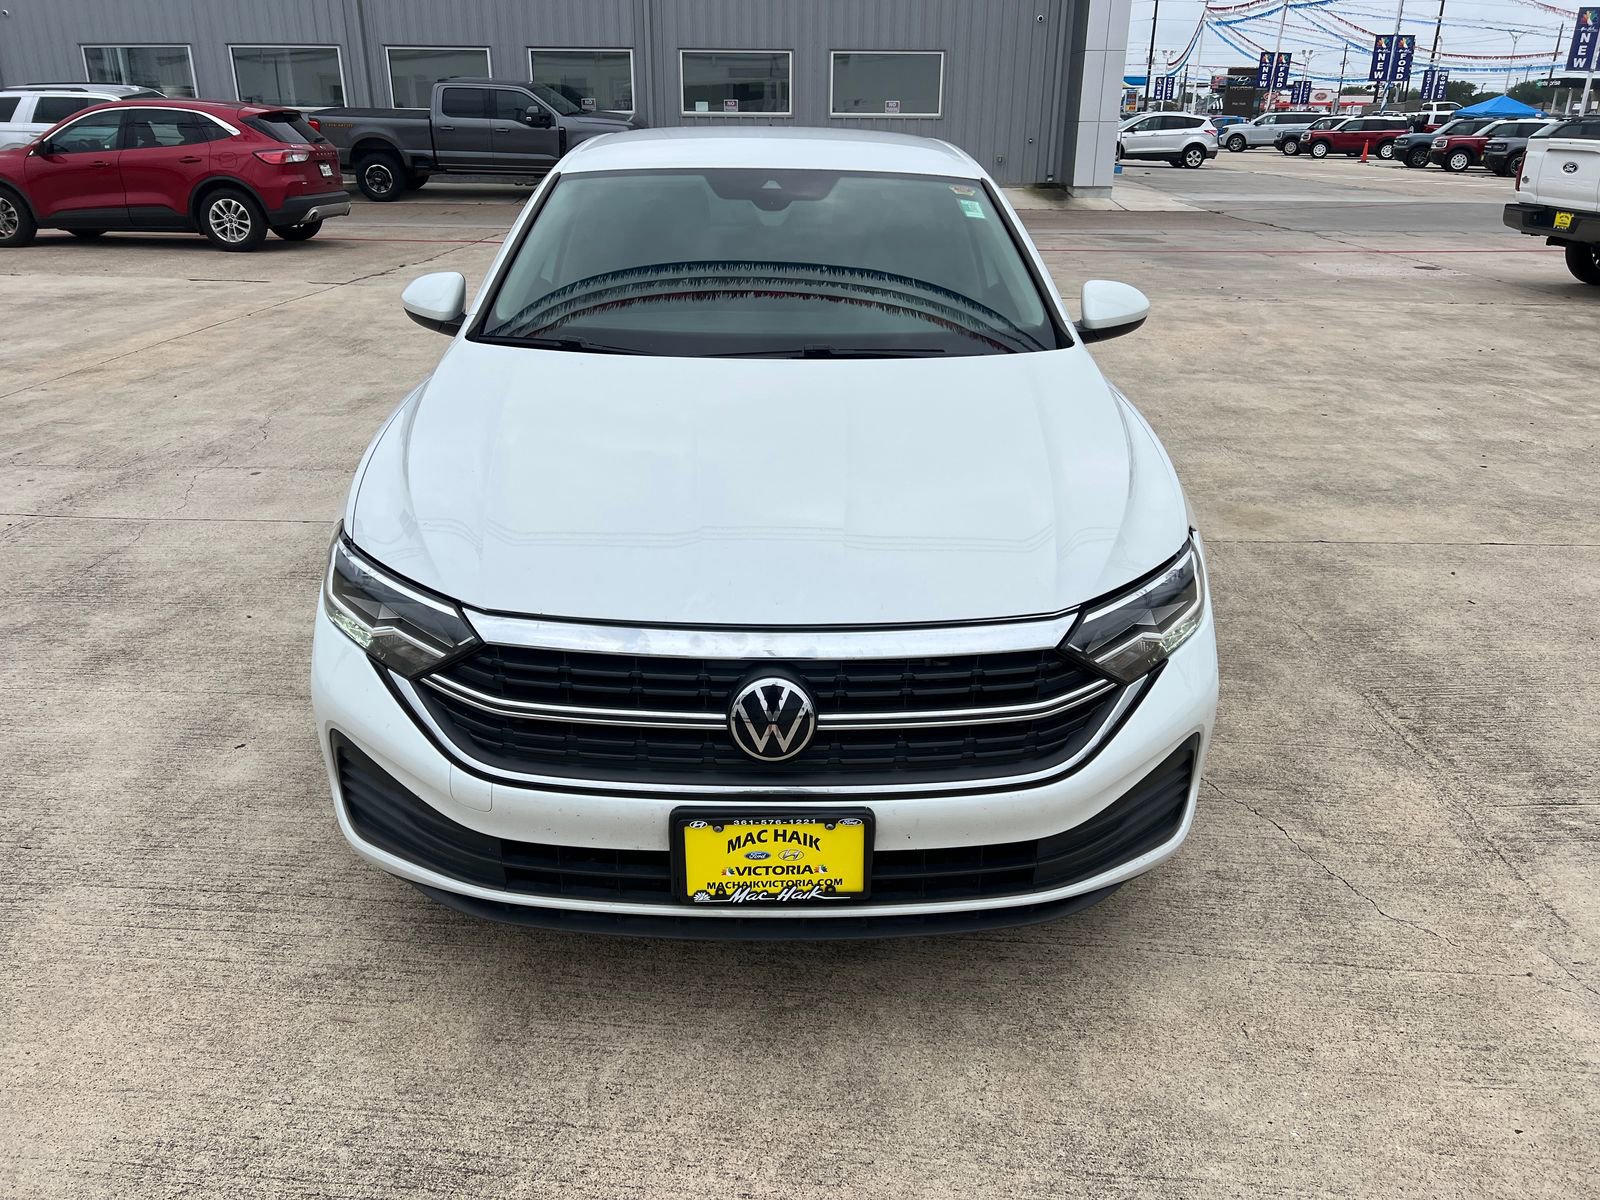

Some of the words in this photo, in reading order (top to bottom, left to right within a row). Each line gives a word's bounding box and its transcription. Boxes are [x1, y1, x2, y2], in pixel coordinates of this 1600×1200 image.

[1573, 32, 1591, 68] NEW
[1259, 66, 1269, 87] NEW
[1276, 66, 1285, 87] FORD
[1374, 53, 1386, 79] NEW
[1396, 53, 1407, 79] FORD
[727, 829, 768, 854] MAC
[774, 829, 821, 852] HAIK
[746, 851, 769, 860] Ford
[735, 864, 814, 877] VICTORIA
[707, 878, 843, 890] MACHAIKVICTORIA.COM
[731, 887, 774, 904] Mac
[776, 885, 842, 901] Haik
